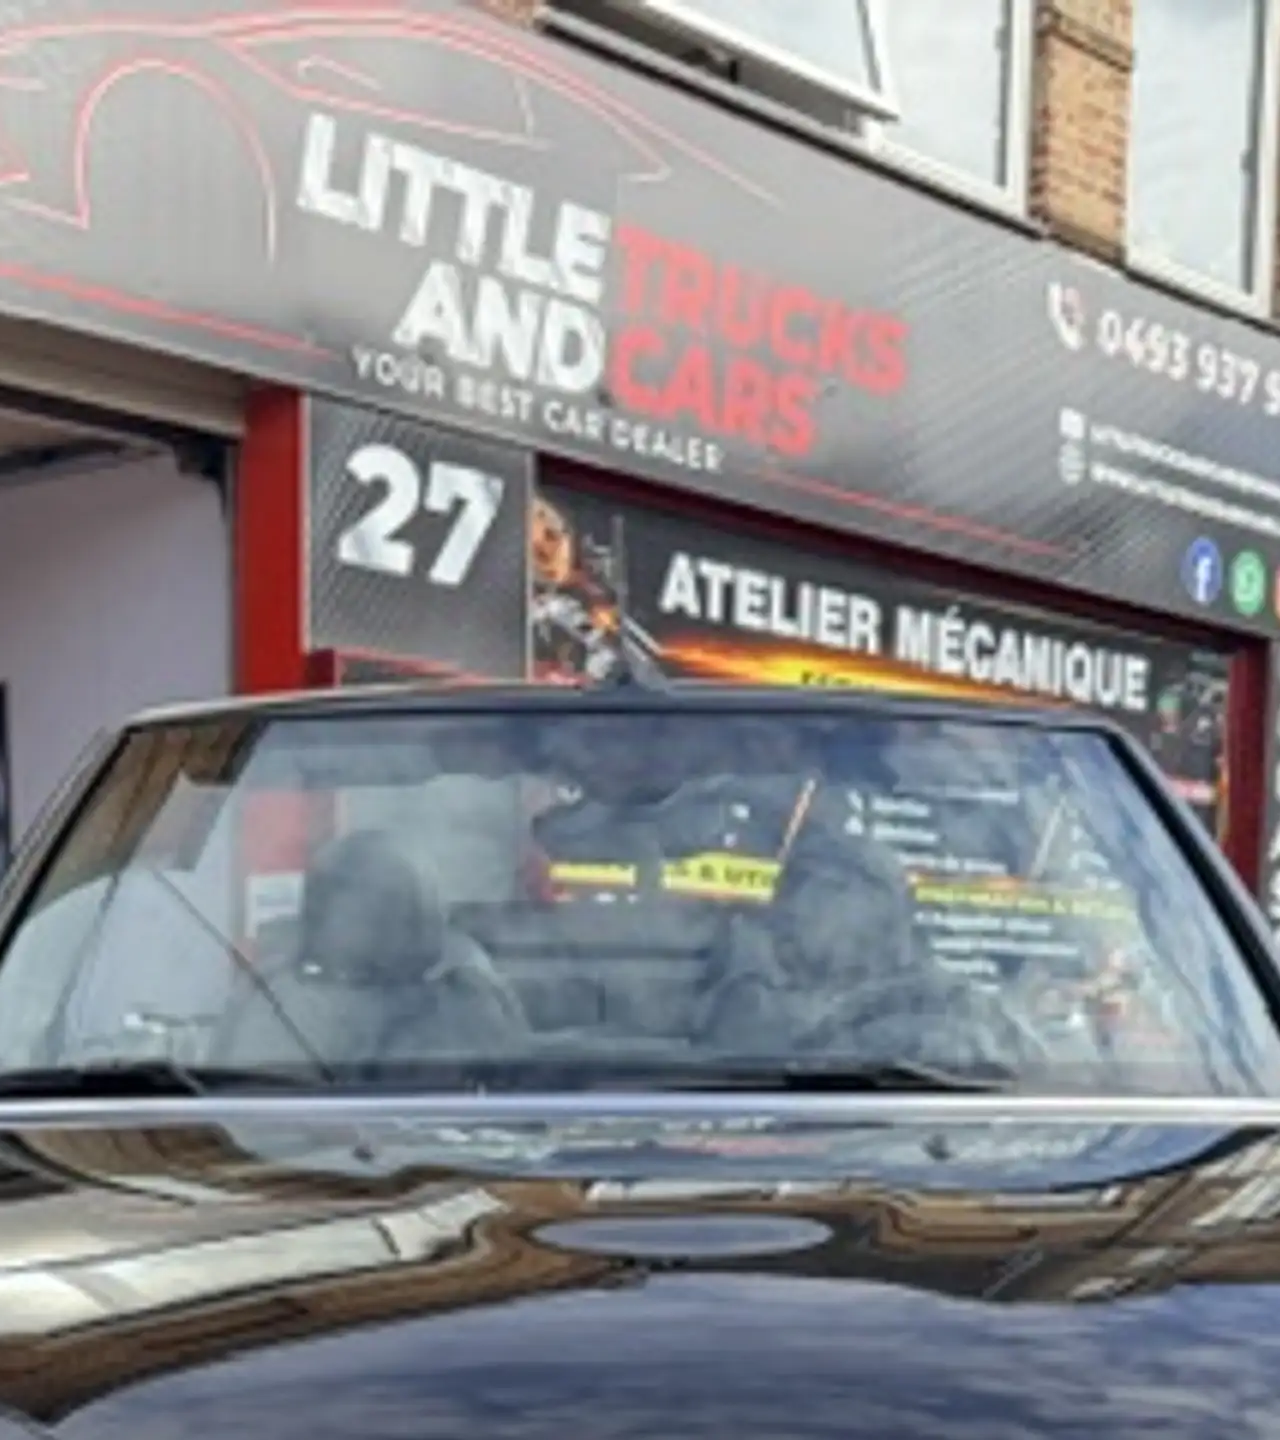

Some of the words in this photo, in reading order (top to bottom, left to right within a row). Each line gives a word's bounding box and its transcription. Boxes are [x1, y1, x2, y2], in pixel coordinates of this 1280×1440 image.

[297, 113, 611, 302] LITTLE
[615, 221, 910, 394] TRUCKS
[353, 345, 444, 399] YOUR
[456, 375, 533, 422] BEST
[544, 401, 604, 440] CAR
[610, 415, 725, 472] DEALER
[392, 260, 606, 393] AND
[605, 324, 816, 457] CARS
[1196, 342, 1260, 406] 937
[337, 444, 504, 585] 27
[660, 553, 881, 655] ATELIER
[896, 607, 1149, 711] MÉCANIQUE
